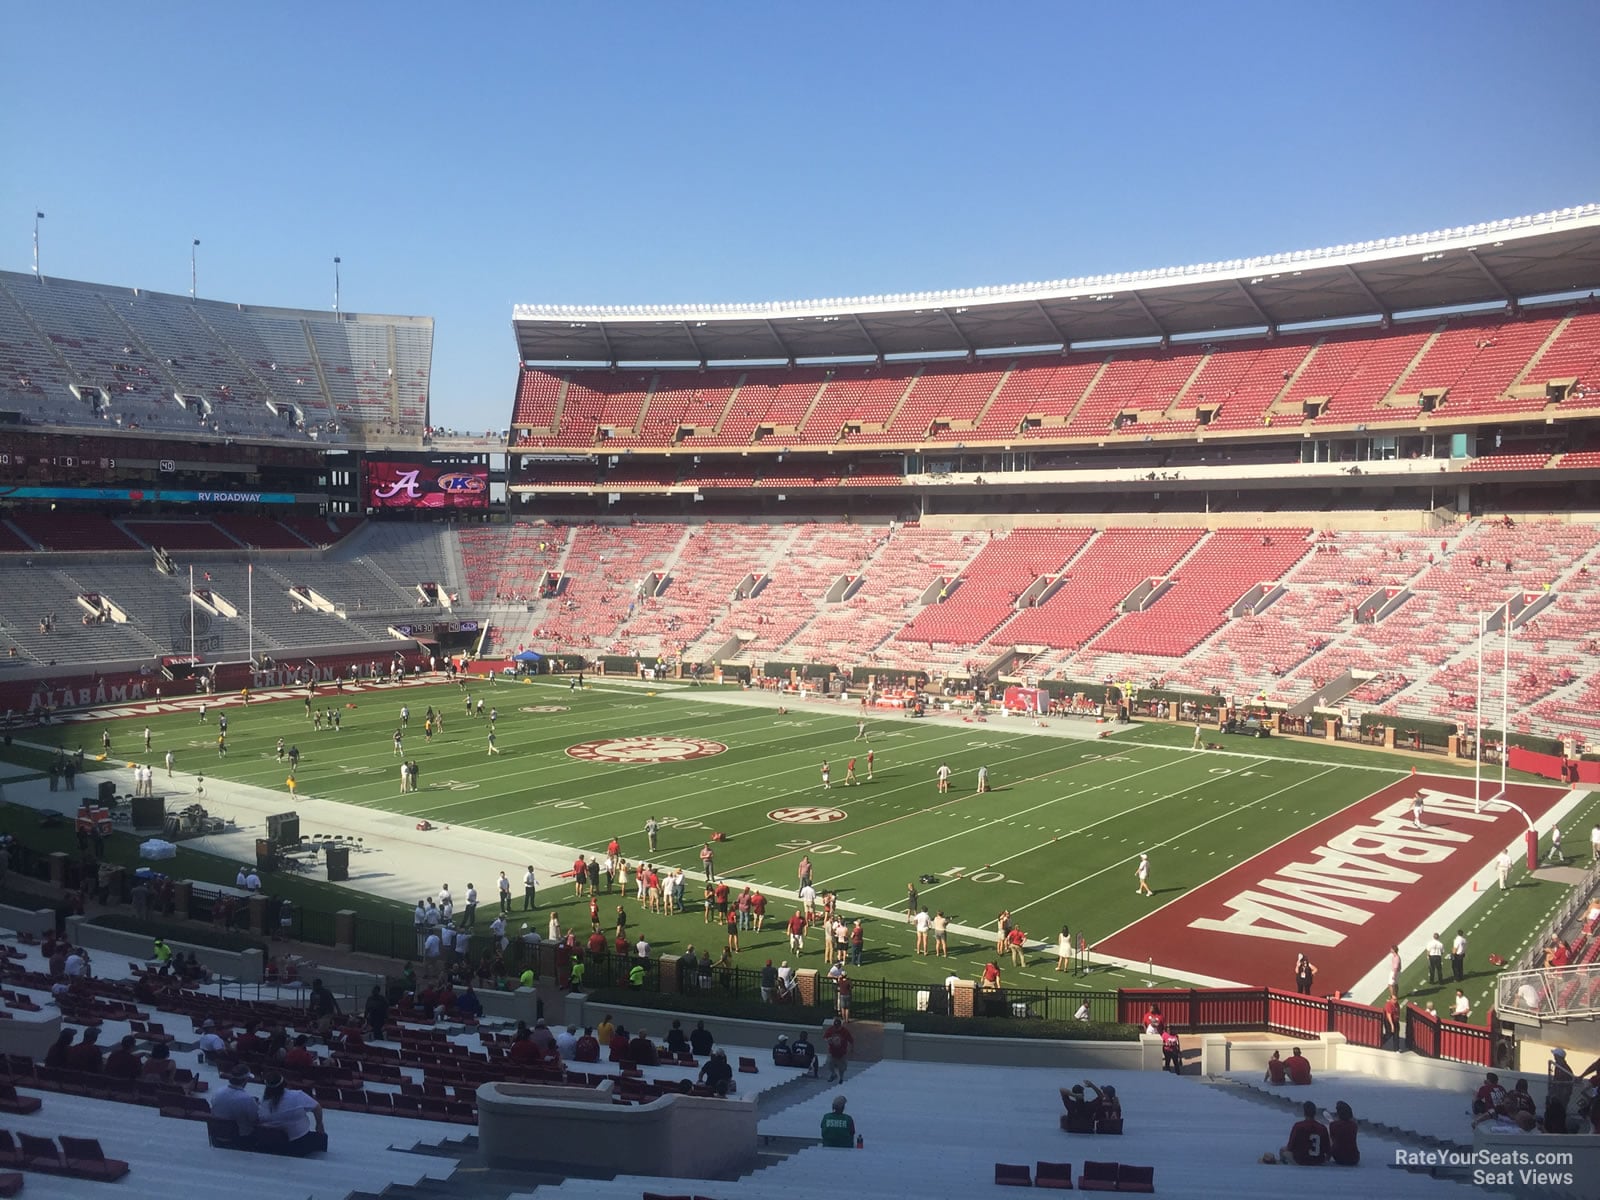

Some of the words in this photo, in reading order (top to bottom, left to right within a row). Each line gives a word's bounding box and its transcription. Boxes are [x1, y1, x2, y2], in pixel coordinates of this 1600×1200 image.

[162, 462, 173, 470] 40
[198, 492, 210, 501] RV
[213, 492, 261, 502] ROADWAY
[252, 666, 334, 688] CRIMSON
[27, 683, 143, 712] ALABAMA
[776, 839, 842, 853] 20
[934, 866, 1005, 882] 10
[1187, 788, 1514, 947] ALABAMA
[826, 1119, 847, 1128] USHER
[1309, 1134, 1321, 1156] 3
